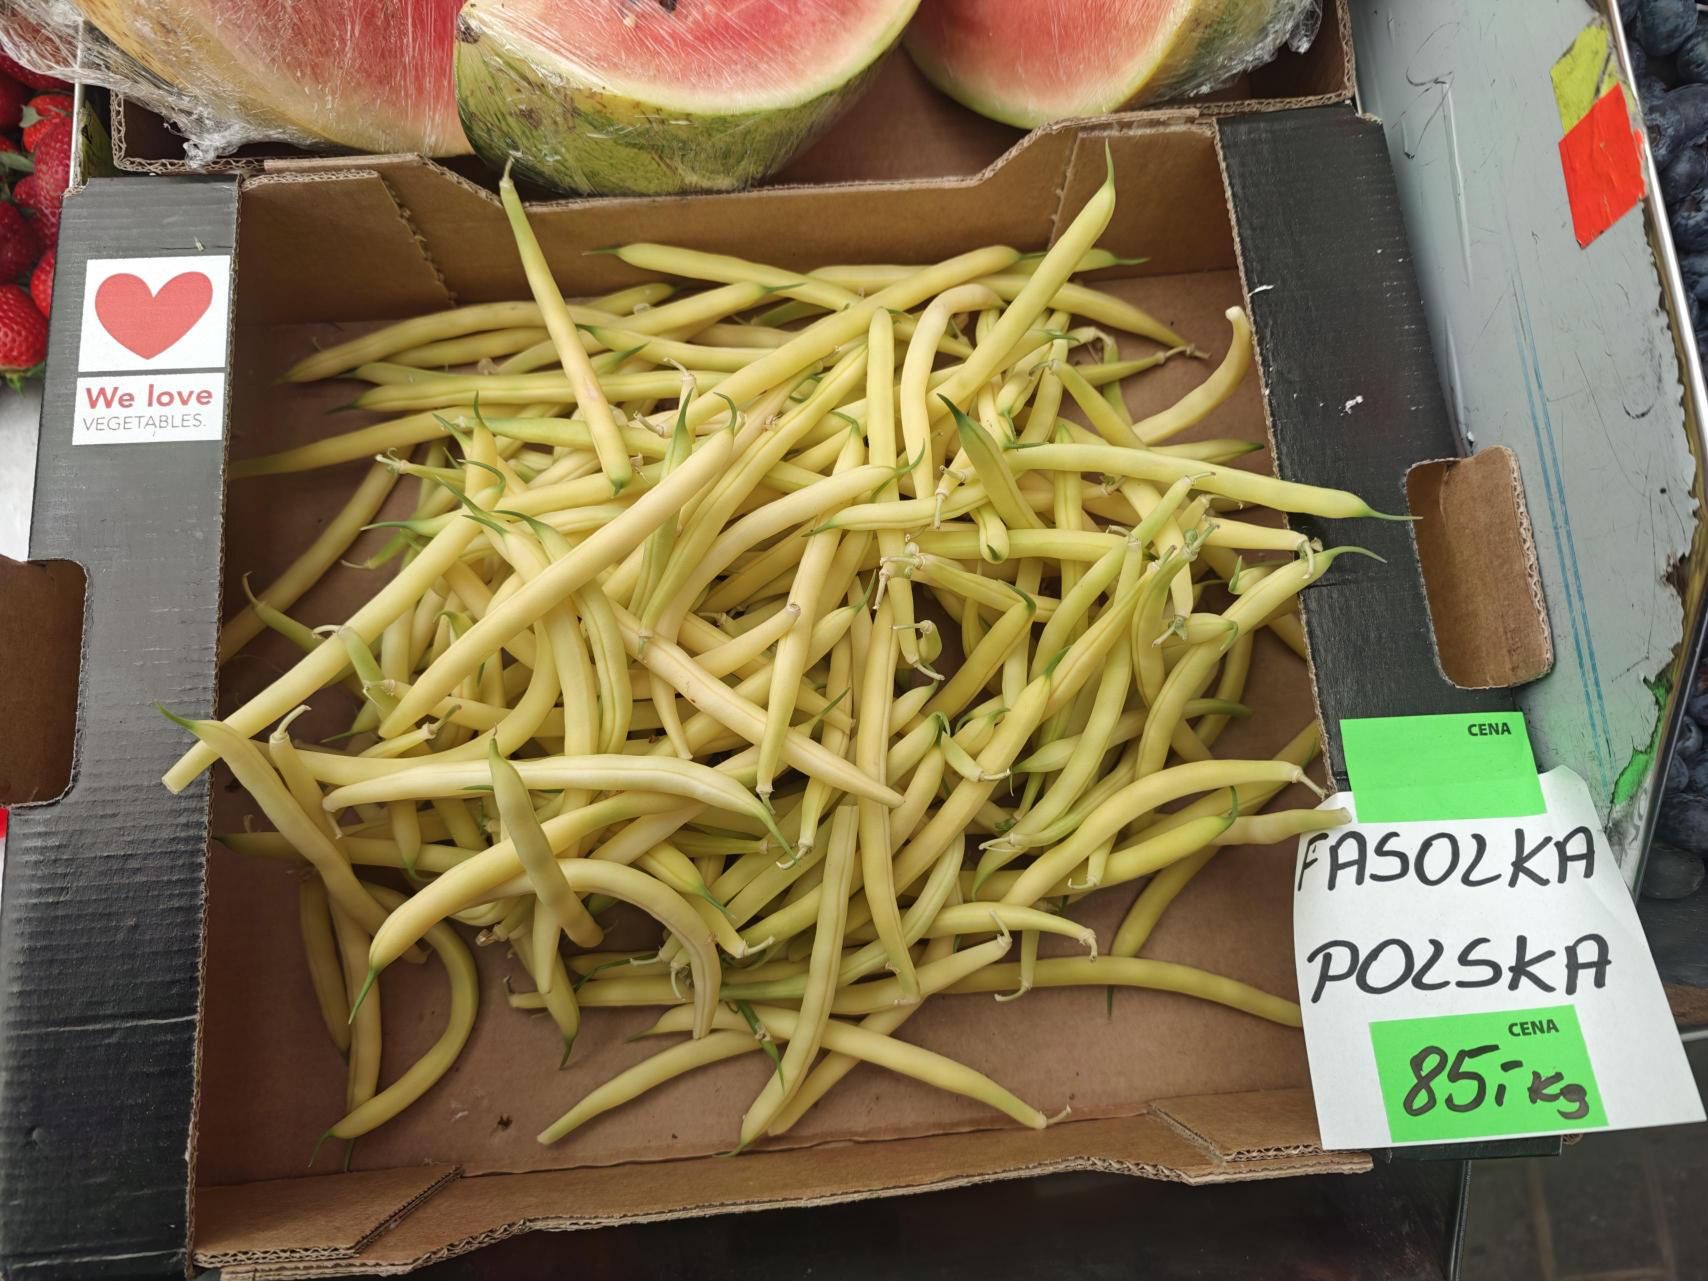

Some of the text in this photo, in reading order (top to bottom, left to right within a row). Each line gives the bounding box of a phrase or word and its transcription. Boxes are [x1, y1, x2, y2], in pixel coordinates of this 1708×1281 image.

[86, 383, 213, 409] We love
[1467, 722, 1512, 737] CENA
[1297, 825, 1596, 891] FASOLKA
[1307, 933, 1612, 1004] POLSKA
[1508, 1018, 1560, 1037] CENA
